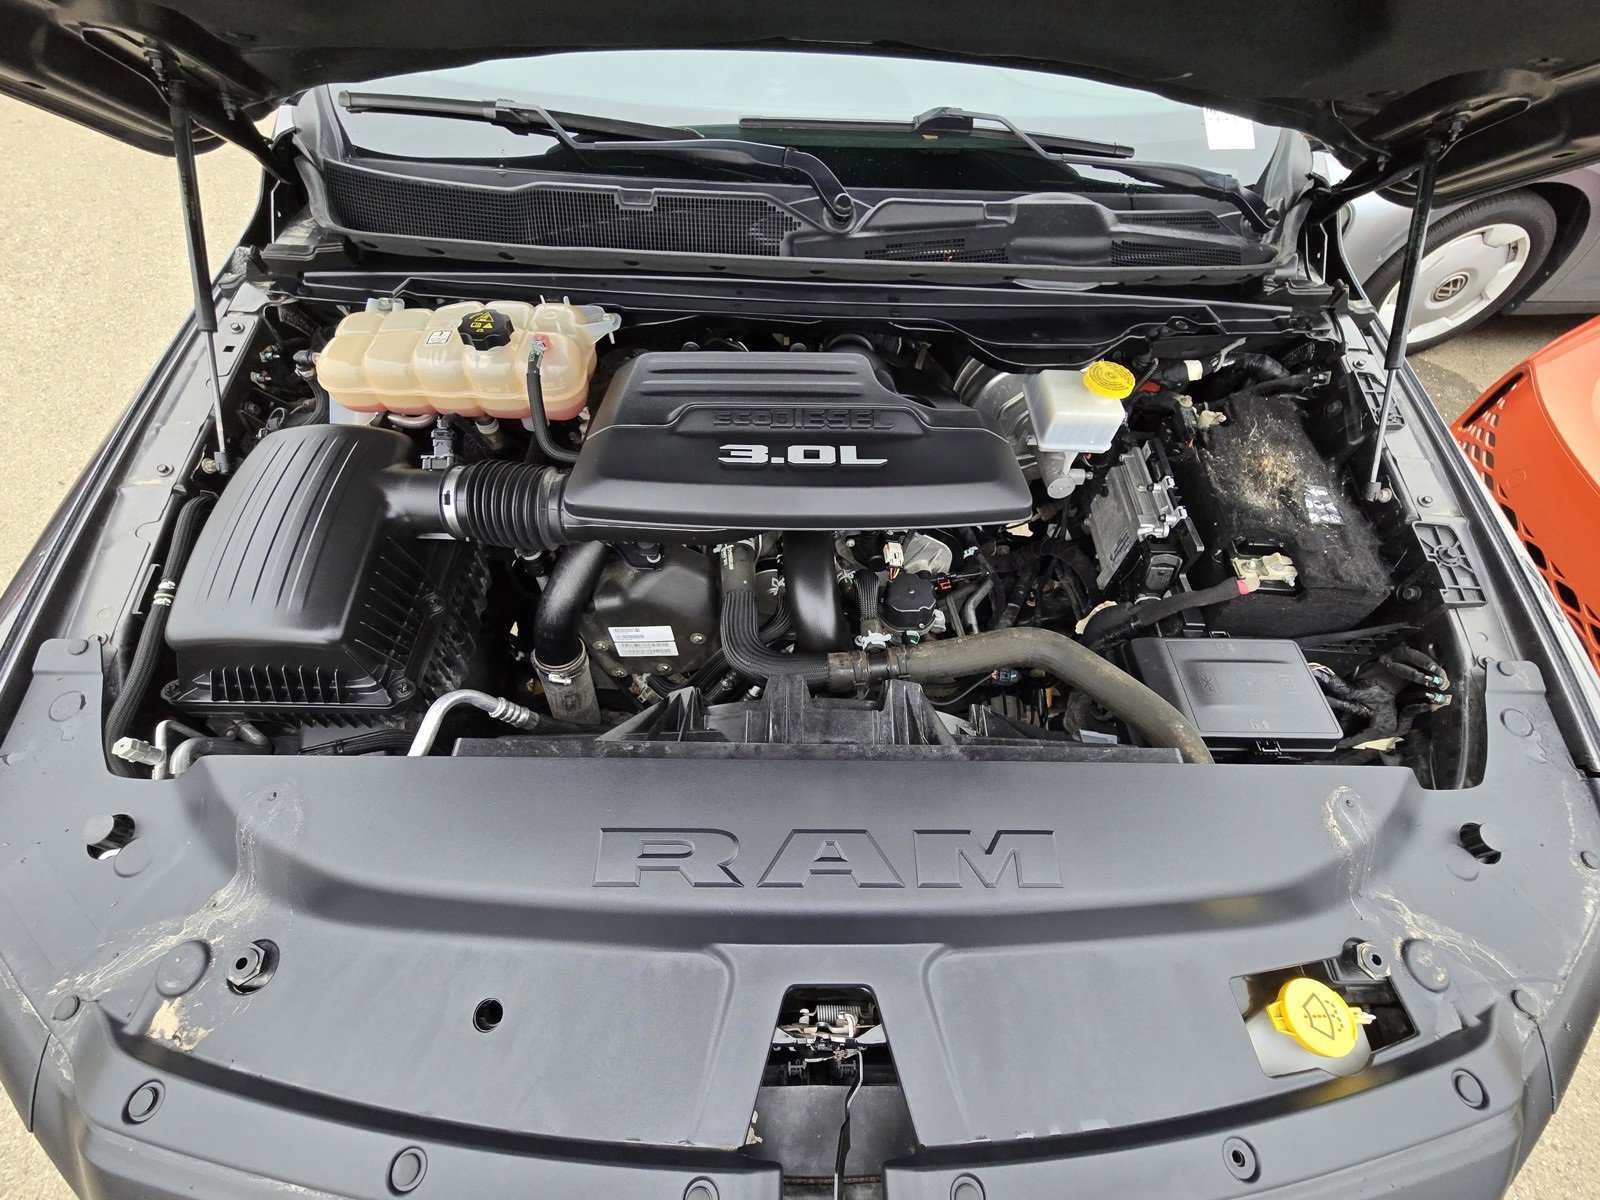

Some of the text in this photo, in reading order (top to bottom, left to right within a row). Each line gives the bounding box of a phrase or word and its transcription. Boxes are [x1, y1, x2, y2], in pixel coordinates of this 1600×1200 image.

[712, 408, 894, 430] ECODIESEL
[717, 444, 889, 465] 3.0L
[592, 827, 1064, 888] RAM
